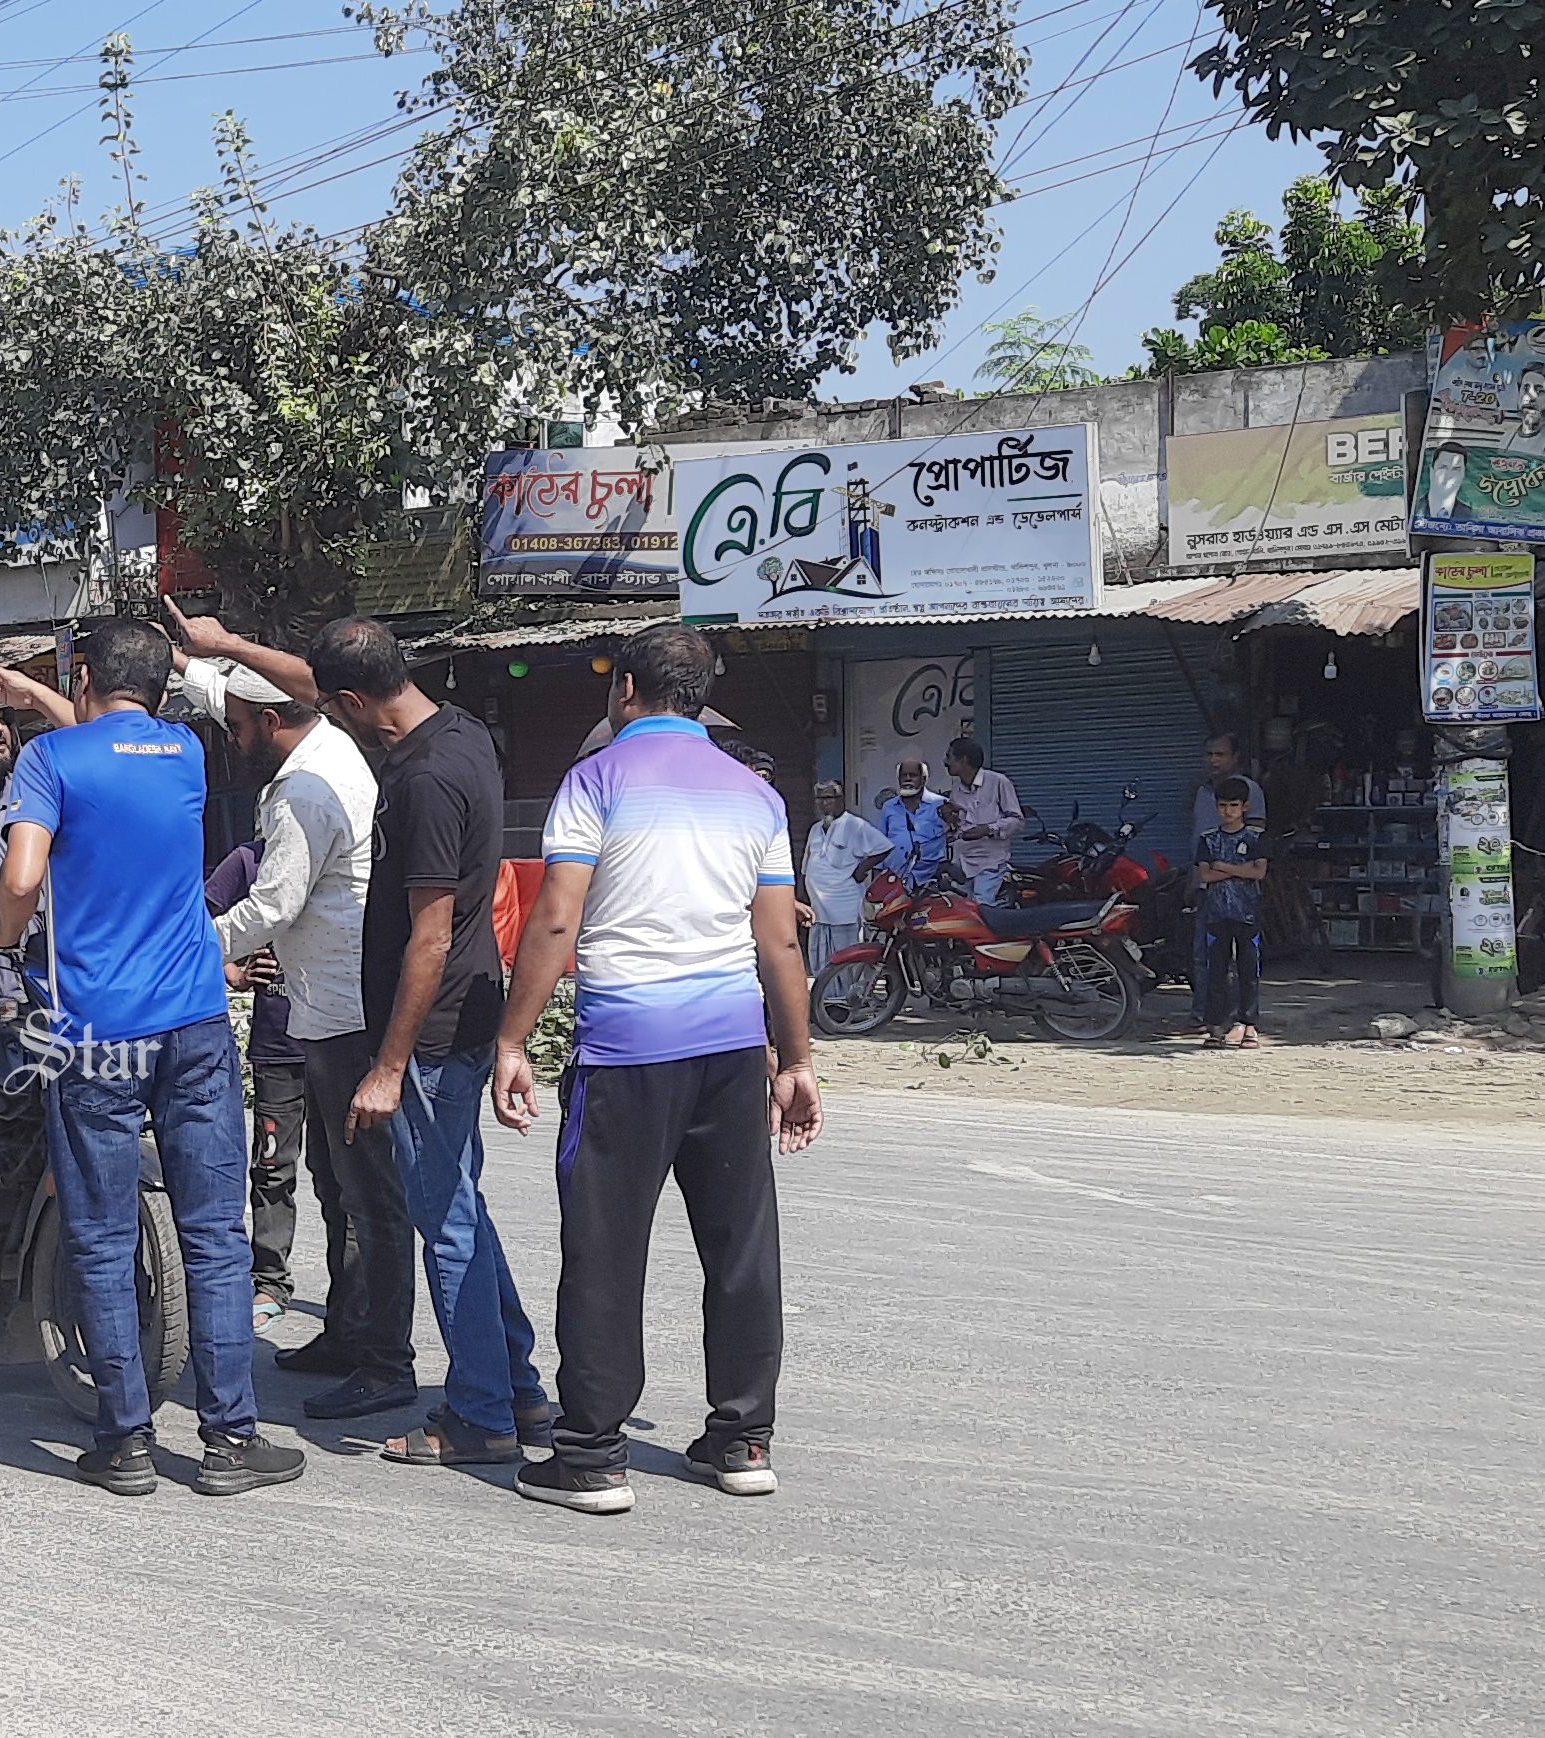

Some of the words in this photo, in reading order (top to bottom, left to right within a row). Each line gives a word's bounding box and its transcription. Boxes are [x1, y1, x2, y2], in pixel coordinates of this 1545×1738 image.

[1461, 390, 1496, 404] T-20
[908, 434, 1074, 507] প্রোপার্টিজ
[1329, 469, 1365, 483] বার্জার
[1369, 465, 1404, 481] পেইন্ট
[488, 452, 584, 518] কাঠের
[585, 468, 654, 530] চুলা
[1186, 532, 1229, 550] নুসরাত
[582, 572, 612, 585] বাস
[114, 743, 162, 754] BANGLADESH
